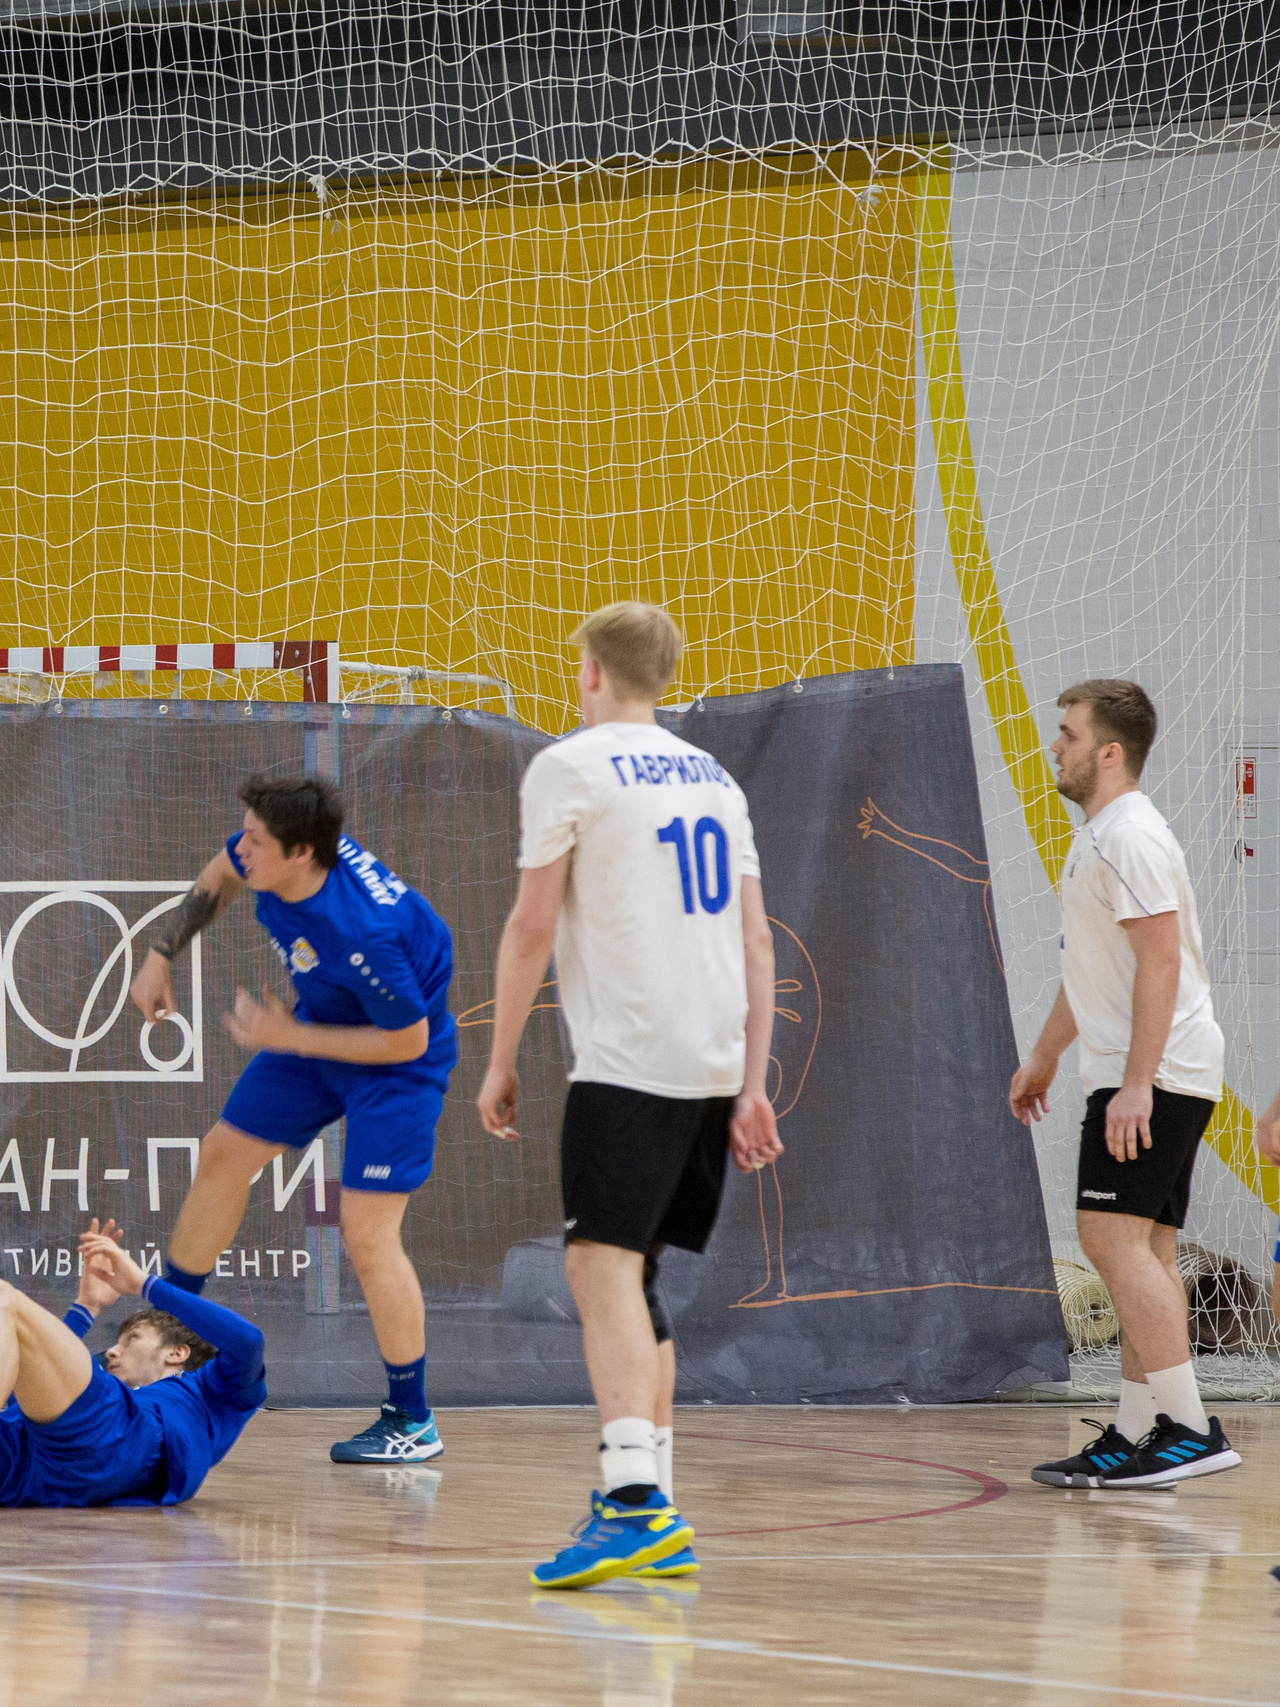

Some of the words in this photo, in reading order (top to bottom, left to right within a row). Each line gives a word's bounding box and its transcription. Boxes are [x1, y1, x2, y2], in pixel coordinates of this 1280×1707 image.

[610, 754, 731, 789] ГАВРИЛО
[656, 815, 732, 915] 10
[215, 1249, 311, 1277] ЕНТР
